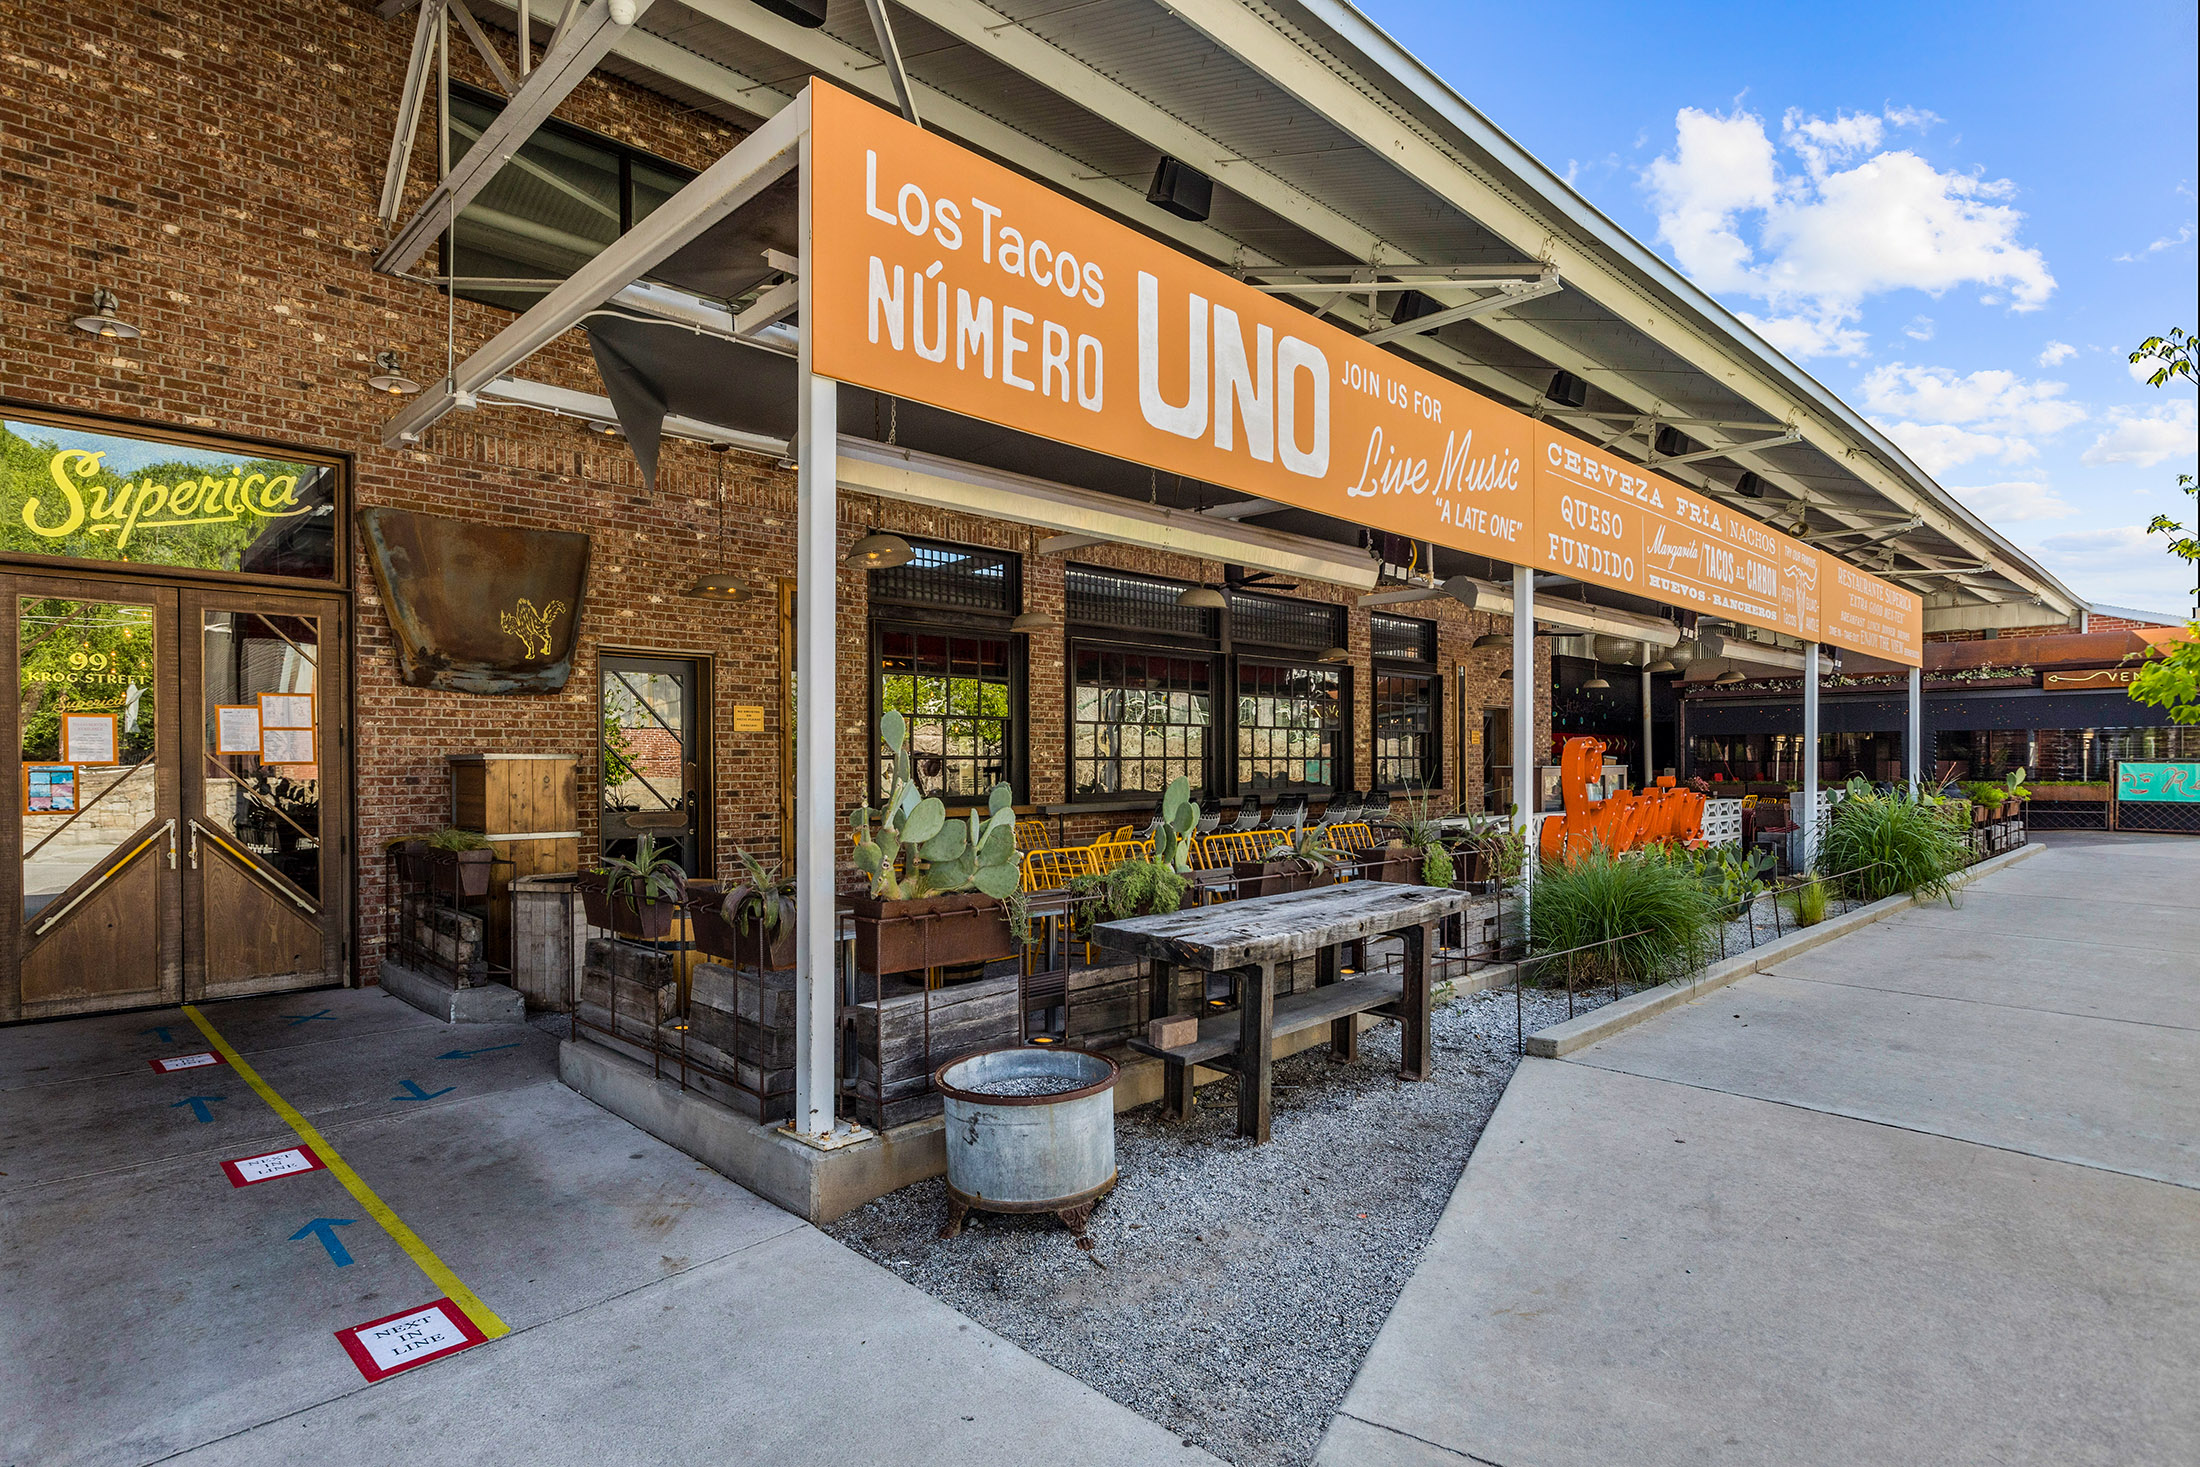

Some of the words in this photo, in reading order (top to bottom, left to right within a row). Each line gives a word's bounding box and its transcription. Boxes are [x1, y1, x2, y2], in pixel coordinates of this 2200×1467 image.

[865, 149, 963, 250] Los
[971, 197, 1105, 308] Tacos
[868, 255, 1104, 413] NÚMERO
[1137, 270, 1330, 479] UNO
[1342, 360, 1380, 398] JOIN
[1387, 378, 1408, 409] US
[1414, 390, 1442, 423] FOR
[1347, 425, 1430, 497] Live
[1432, 429, 1520, 496] Music
[22, 449, 313, 549] Superica
[1547, 442, 1665, 510] CERVEZA
[1676, 496, 1723, 533] FRÍA
[1455, 503, 1488, 534] LATE
[1561, 495, 1623, 540] QUESO
[1729, 519, 1777, 555] NACHOS
[1548, 532, 1635, 583] FUNDIDO
[1647, 524, 1698, 570] Margarita
[1704, 543, 1735, 585] TACOS
[1735, 565, 1746, 581] AL
[1746, 559, 1777, 598] CARBON
[1837, 566, 1884, 601] RESTAURANTE
[1884, 587, 1913, 613] SUPERICA
[1649, 574, 1706, 602] HUEVOS
[1712, 593, 1778, 621] RANCHEROS
[1868, 601, 1884, 617] GOOD
[69, 652, 108, 671] 99
[1860, 629, 1878, 648] ENJOY
[1878, 635, 1891, 652] THE
[28, 671, 79, 683] KROG
[85, 673, 148, 685] STREET
[248, 1153, 292, 1167] NEXT
[258, 1162, 298, 1175] LINE
[264, 1160, 282, 1168] IN
[373, 1315, 432, 1340] NEXT
[391, 1333, 445, 1357] LINE
[398, 1329, 423, 1342] IN
